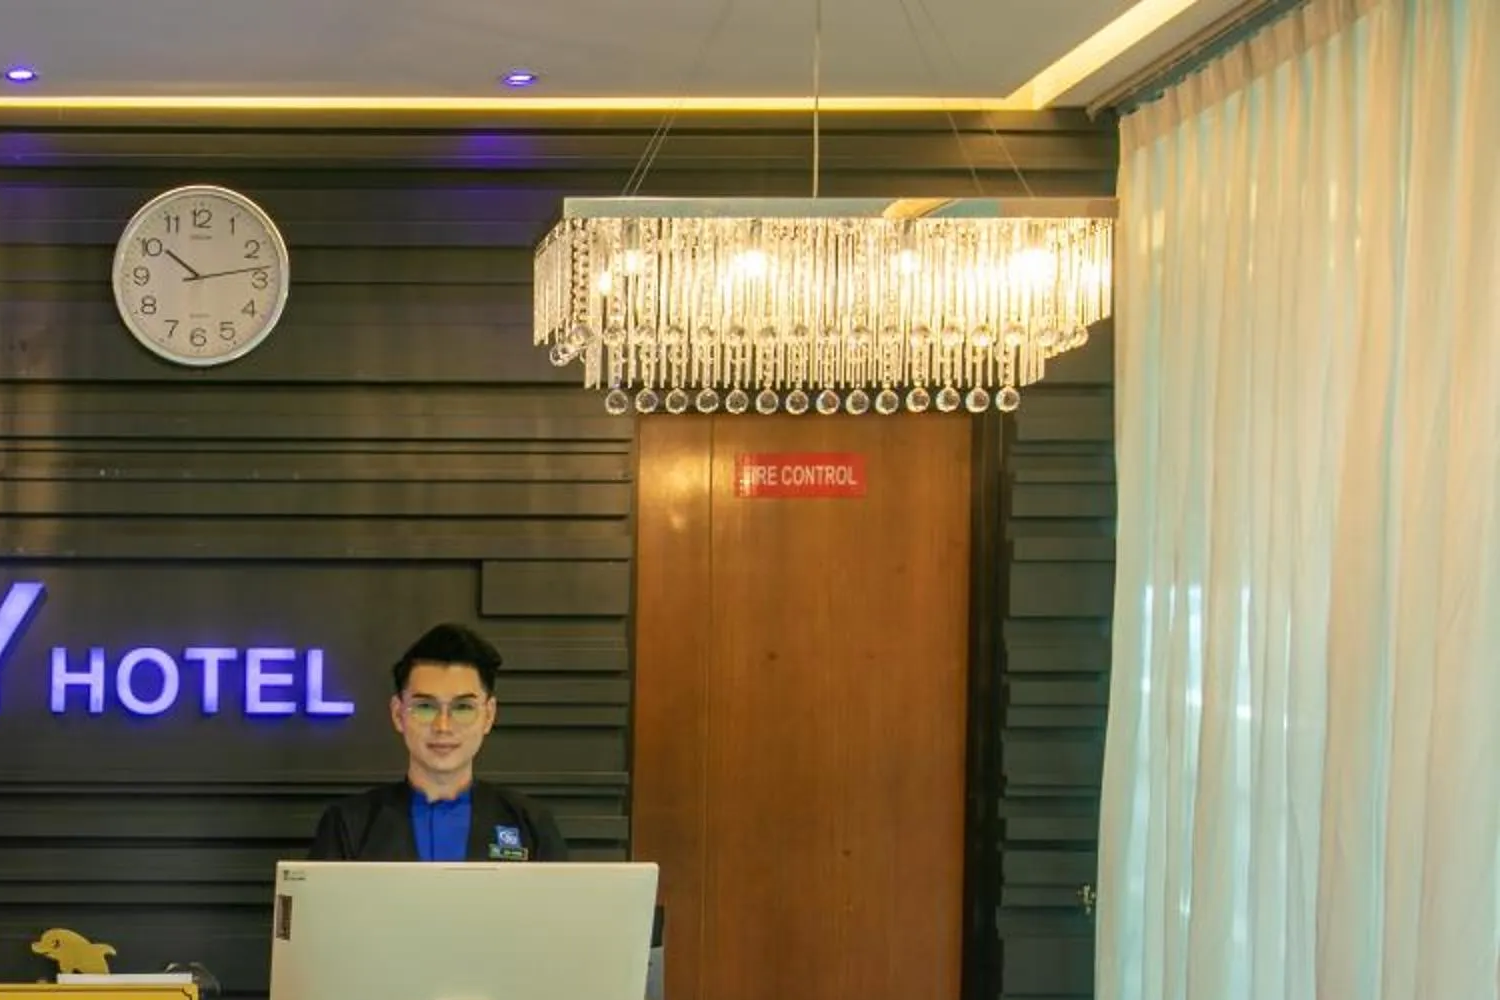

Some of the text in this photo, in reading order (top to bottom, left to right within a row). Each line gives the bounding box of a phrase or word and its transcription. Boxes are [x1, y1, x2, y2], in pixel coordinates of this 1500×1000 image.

[164, 215, 180, 234] 11
[192, 208, 213, 229] 12
[229, 217, 236, 236] 1
[141, 238, 163, 257] 10
[244, 239, 261, 259] 2
[133, 266, 150, 286] 9
[251, 270, 269, 289] 3
[140, 295, 157, 315] 8
[241, 299, 257, 318] 4
[164, 319, 180, 338] 7
[189, 327, 207, 347] 6
[219, 321, 236, 341] 5
[781, 465, 857, 486] CONTROL
[51, 646, 355, 715] HOTEL
